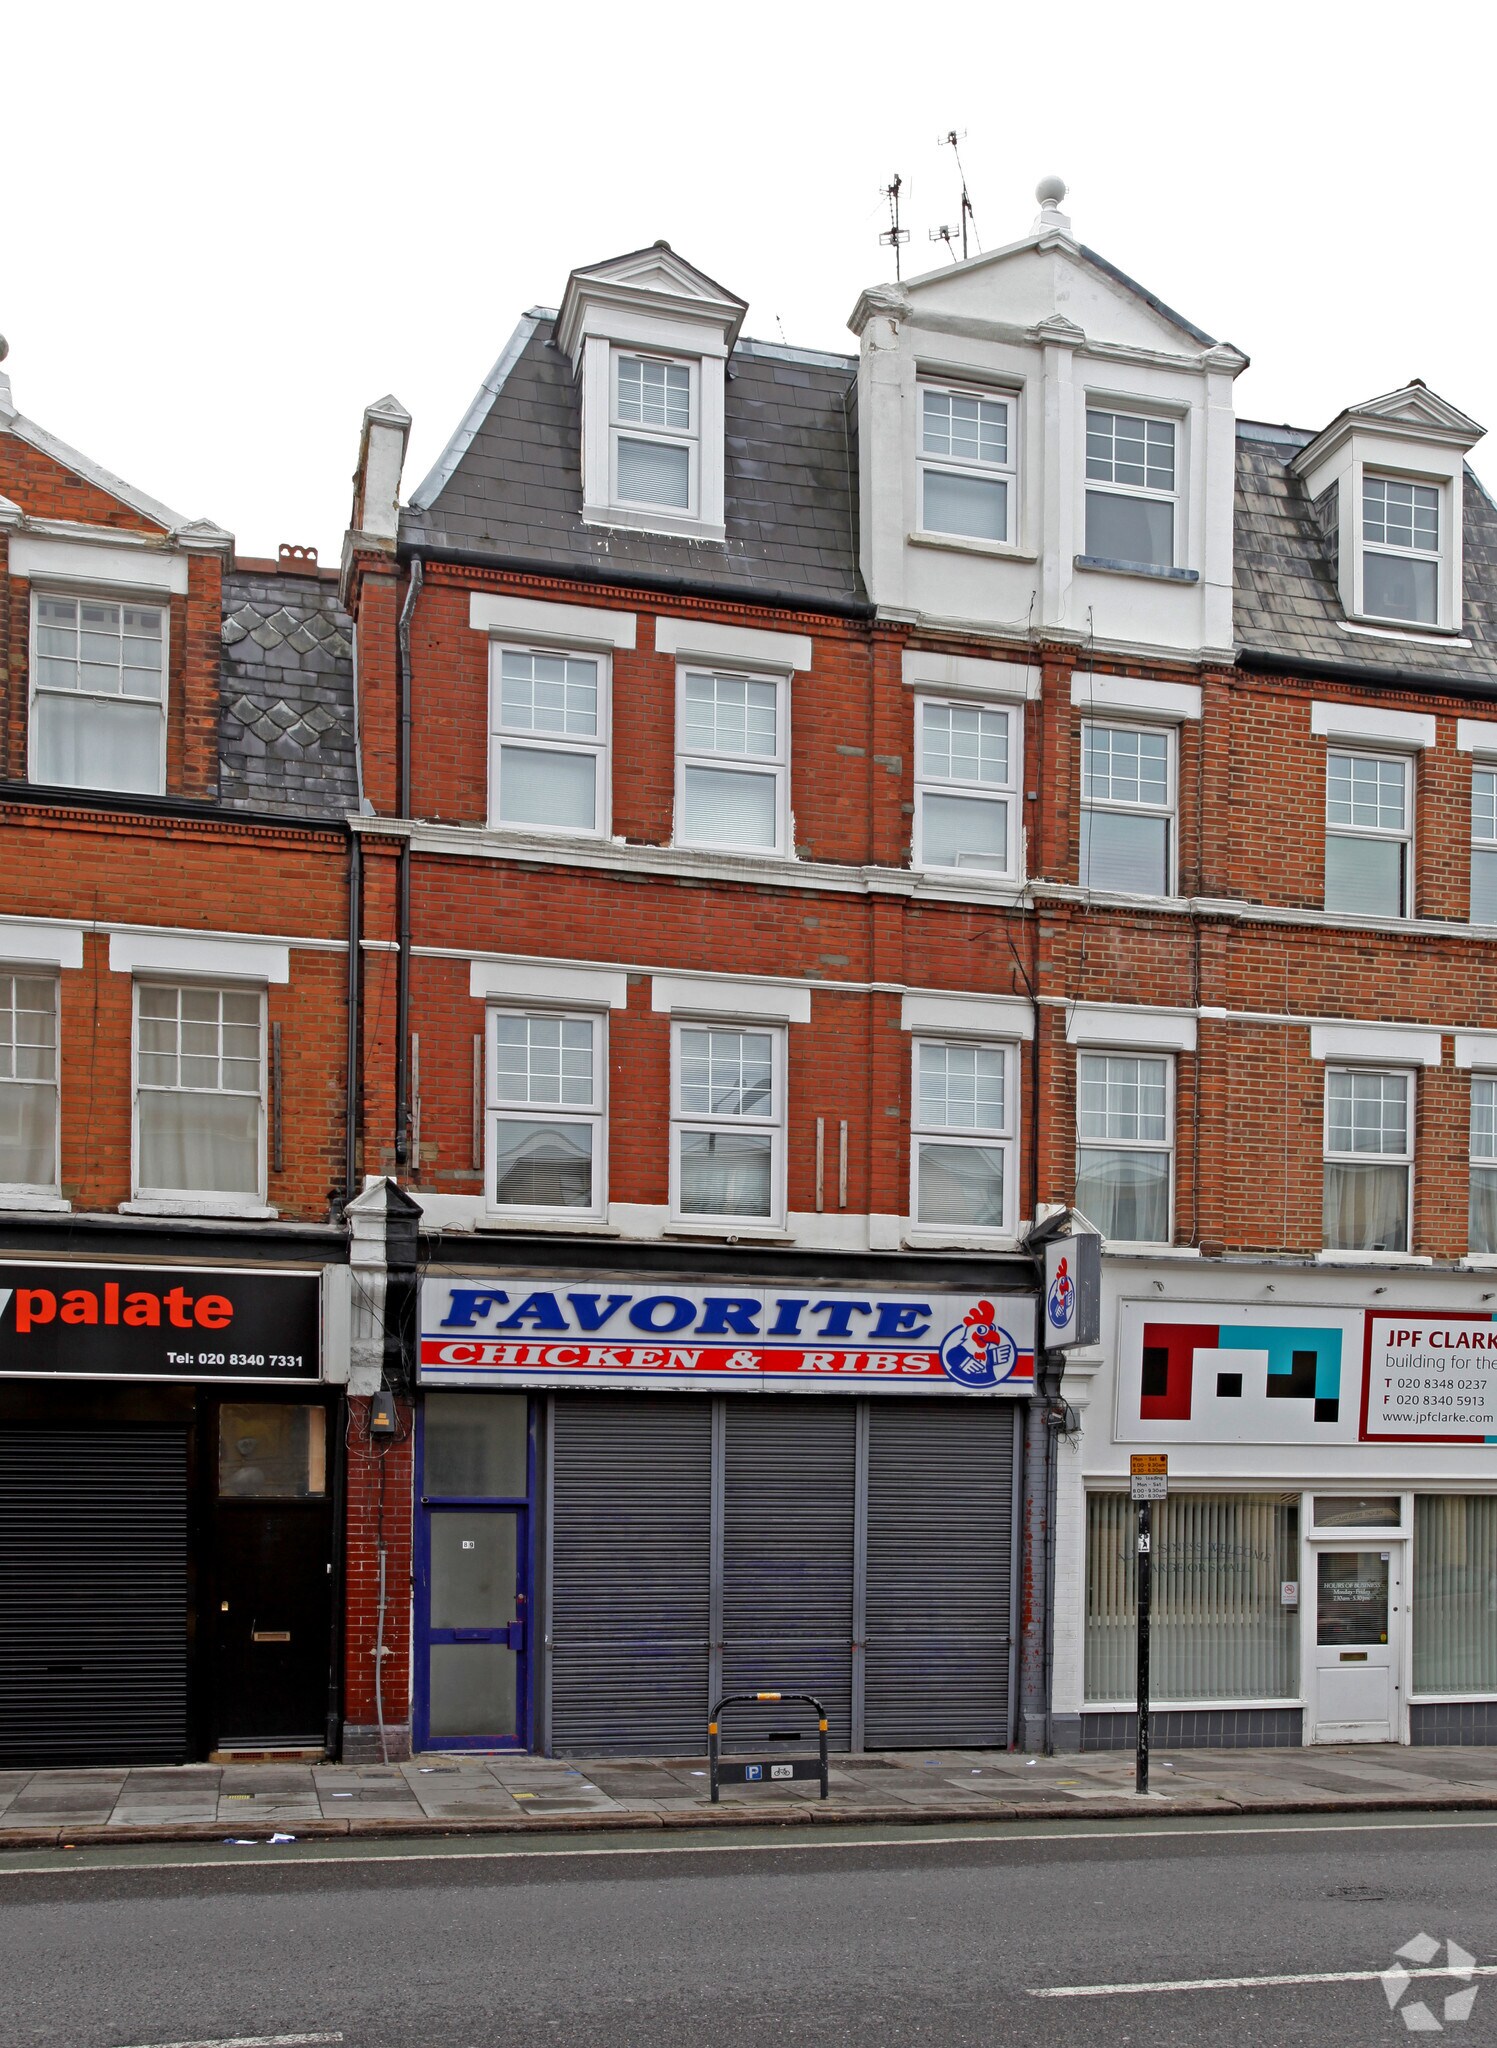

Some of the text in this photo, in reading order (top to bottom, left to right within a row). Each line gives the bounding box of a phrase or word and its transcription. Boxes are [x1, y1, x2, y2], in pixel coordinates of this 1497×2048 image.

[16, 1282, 234, 1333] palate
[439, 1287, 933, 1340] FAVORITE
[1386, 1329, 1423, 1348] JPF
[167, 1351, 303, 1368] Tel: 020 8340 7331
[438, 1342, 932, 1375] CHICKEN & RIBS
[1385, 1353, 1446, 1372] building
[1451, 1355, 1472, 1370] for
[1384, 1378, 1487, 1390] T 020 8348 0237
[1383, 1394, 1485, 1407] F 020 8340 5913
[1382, 1411, 1494, 1424] www.jpfclarke.com
[1150, 1541, 1202, 1556] USINESS
[1206, 1541, 1273, 1564] WELCOME
[1151, 1563, 1250, 1574] ARGE OR SMALL
